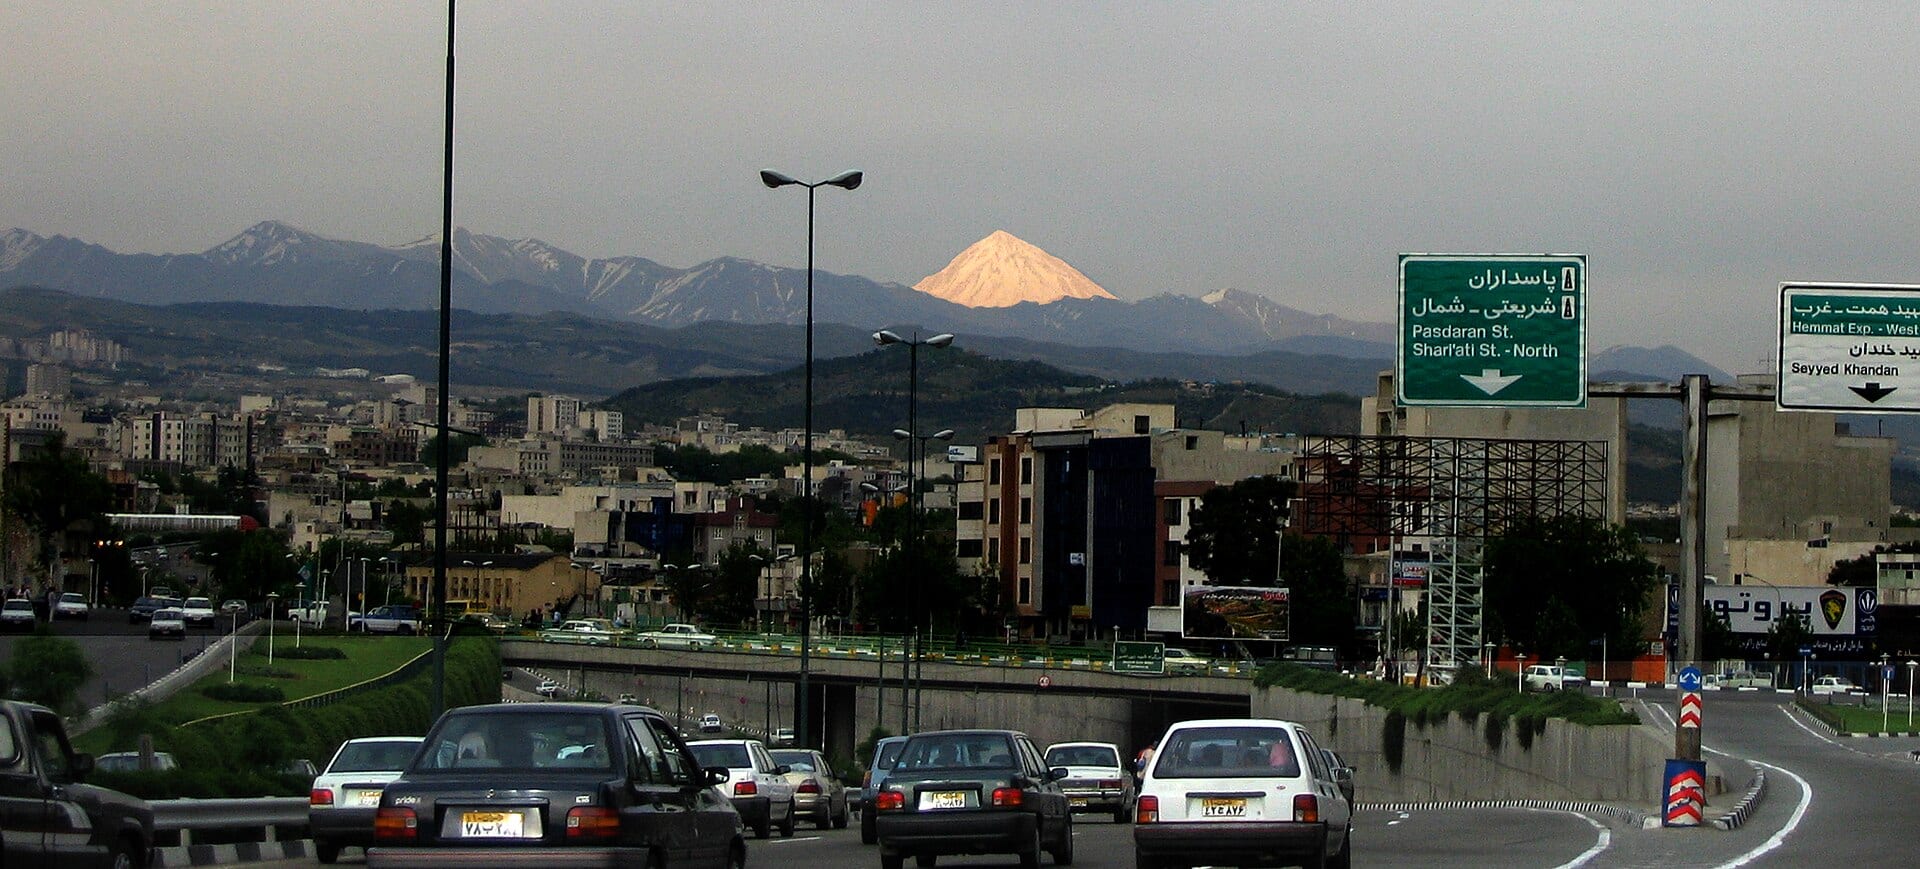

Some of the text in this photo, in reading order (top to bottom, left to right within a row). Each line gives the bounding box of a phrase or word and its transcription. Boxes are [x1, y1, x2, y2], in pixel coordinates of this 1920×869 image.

[1469, 269, 1556, 292] پاسداران
[1412, 296, 1465, 316] شمال
[1484, 297, 1556, 319] شریعتی
[1794, 301, 1832, 318] غرب
[1846, 304, 1888, 316] همت
[1412, 324, 1514, 339] Pasdaran St.
[1792, 321, 1844, 333] Hemmat
[1848, 323, 1874, 335] Exp.
[1412, 343, 1475, 357] Shari'ati
[1479, 344, 1501, 357] St.
[1849, 343, 1895, 357] خندان
[1791, 362, 1899, 376] Seyyed Khandan
[1704, 592, 1812, 626] پروتو
[395, 796, 416, 805] pride
